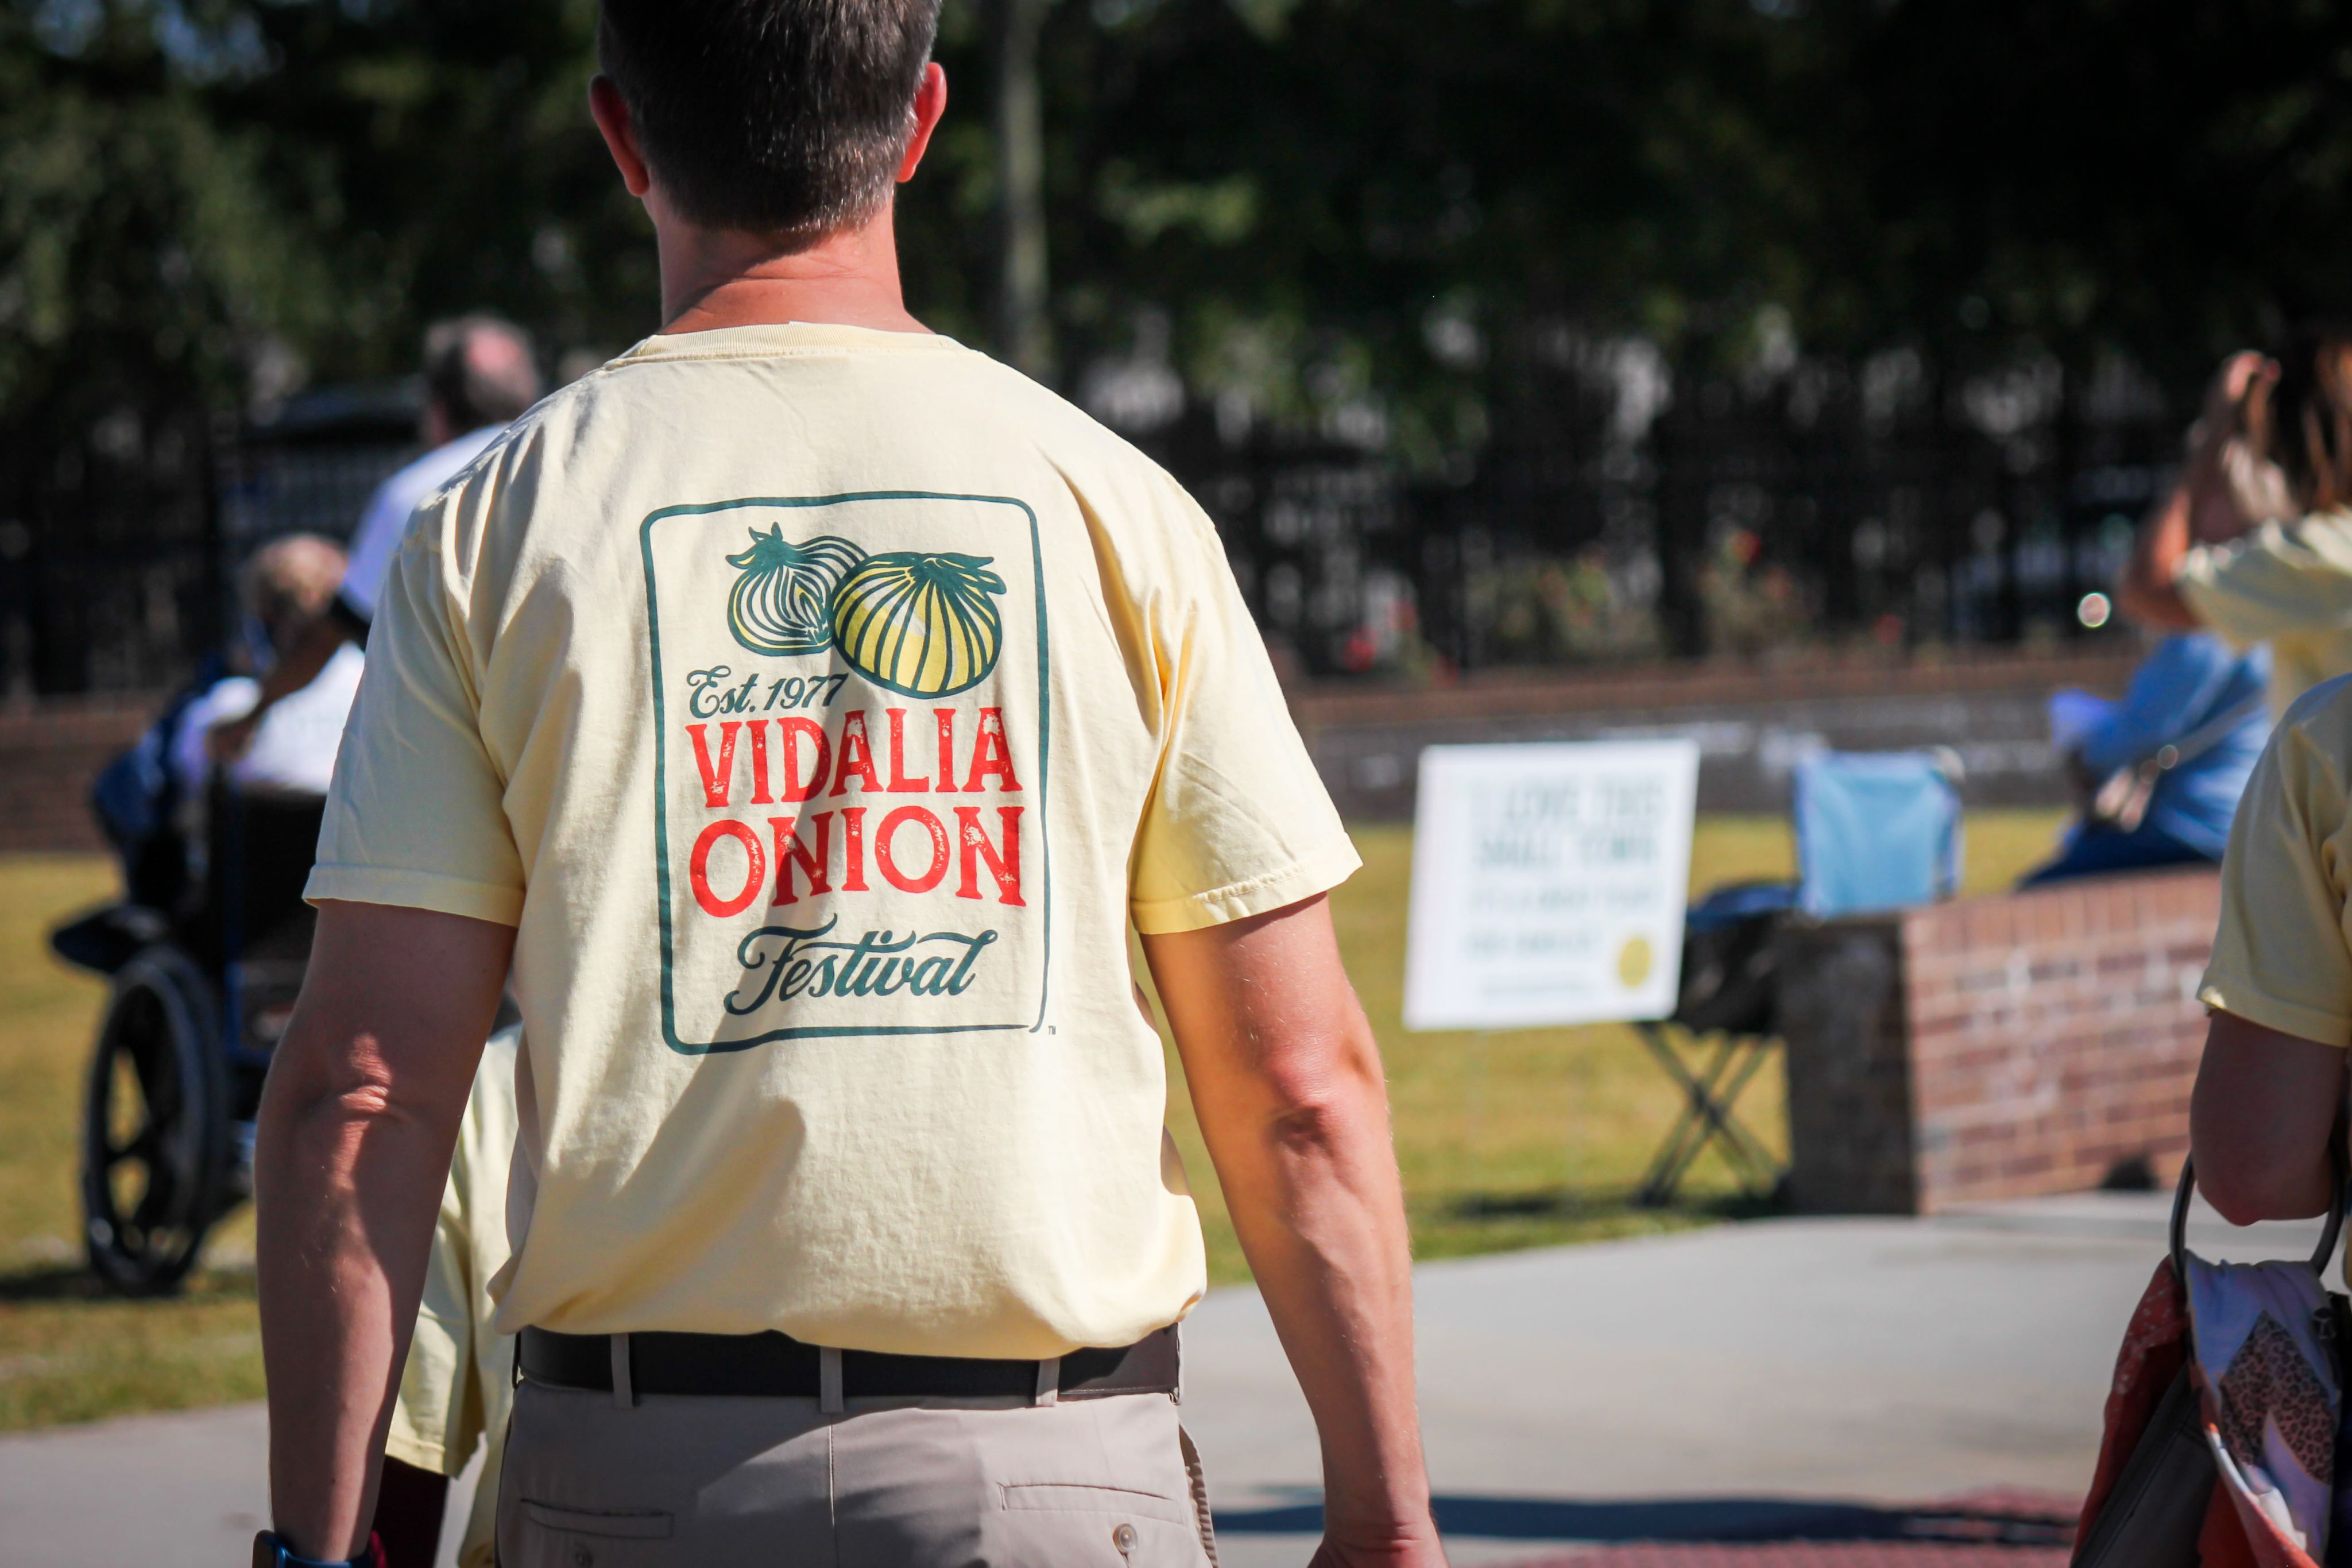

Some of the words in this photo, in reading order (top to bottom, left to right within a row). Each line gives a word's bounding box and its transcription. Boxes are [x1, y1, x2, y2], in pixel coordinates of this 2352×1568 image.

[687, 665, 759, 718] Est.
[765, 672, 849, 711] 1977
[685, 707, 1023, 808] VIDALIA
[689, 805, 1027, 918] ONION
[724, 913, 998, 1016] Festival
